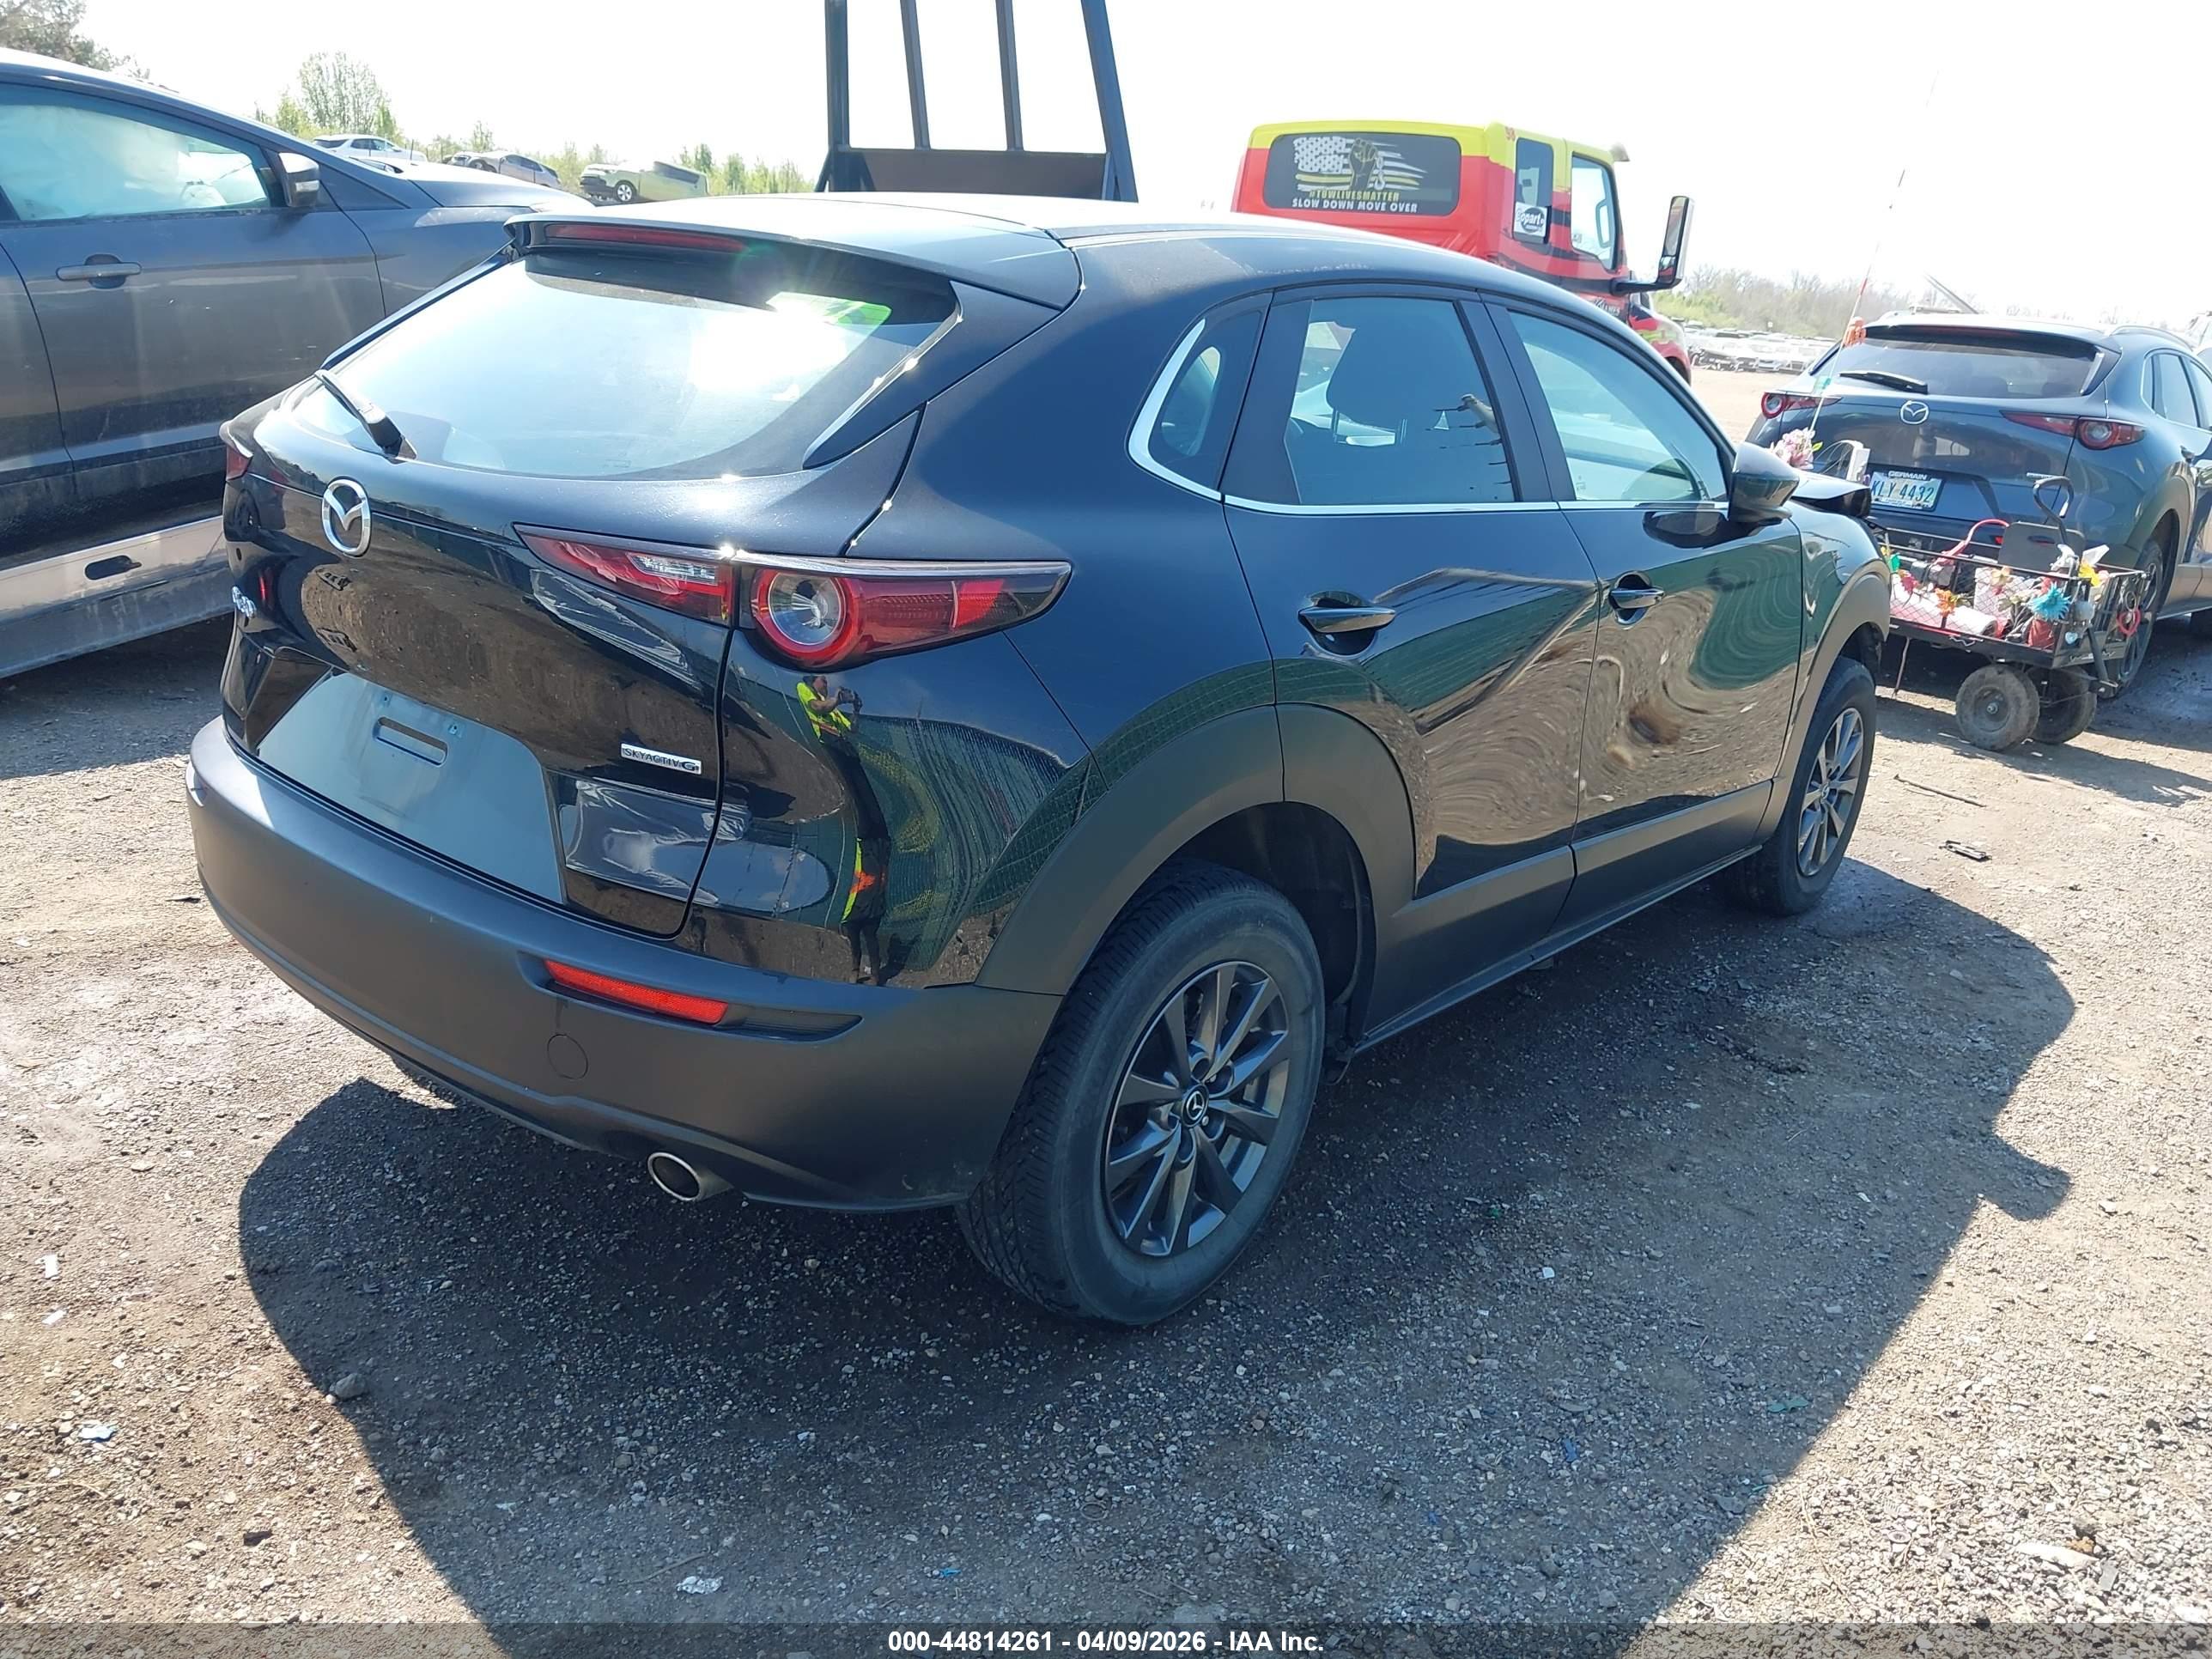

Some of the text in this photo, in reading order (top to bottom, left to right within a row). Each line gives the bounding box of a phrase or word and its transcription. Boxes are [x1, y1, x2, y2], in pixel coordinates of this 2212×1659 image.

[1309, 189, 1400, 202] #TOWLIVESMATTER
[1291, 198, 1418, 213] SLOW DOWN MOVE OVER
[1888, 471, 1928, 480] GERMAIN
[1871, 480, 1897, 497] KLY
[1899, 483, 1935, 503] 4432
